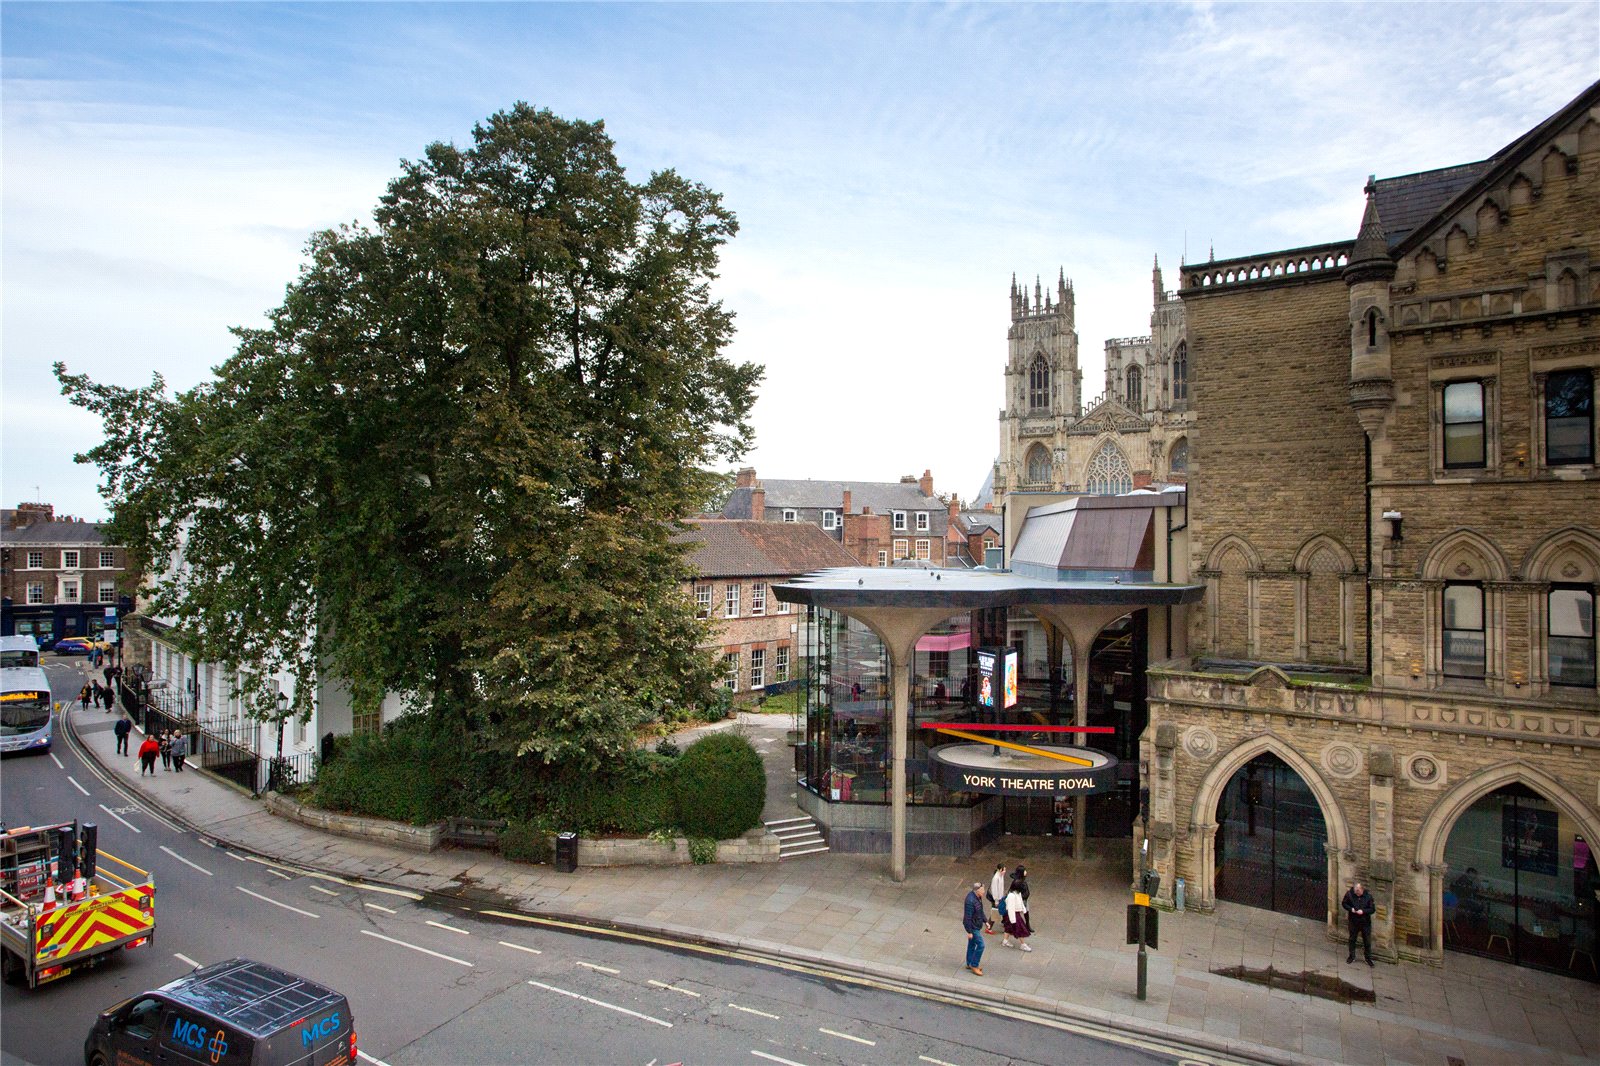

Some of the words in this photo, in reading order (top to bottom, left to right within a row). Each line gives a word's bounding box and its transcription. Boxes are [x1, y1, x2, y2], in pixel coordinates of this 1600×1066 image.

[964, 774, 996, 788] YORK
[1000, 778, 1055, 790] THEATRE
[1058, 778, 1096, 790] ROYAL
[65, 907, 89, 918] HIGHWAY
[89, 897, 124, 910] MAINTENANCE
[172, 1017, 207, 1049] MCS
[301, 1012, 341, 1047] MCS
